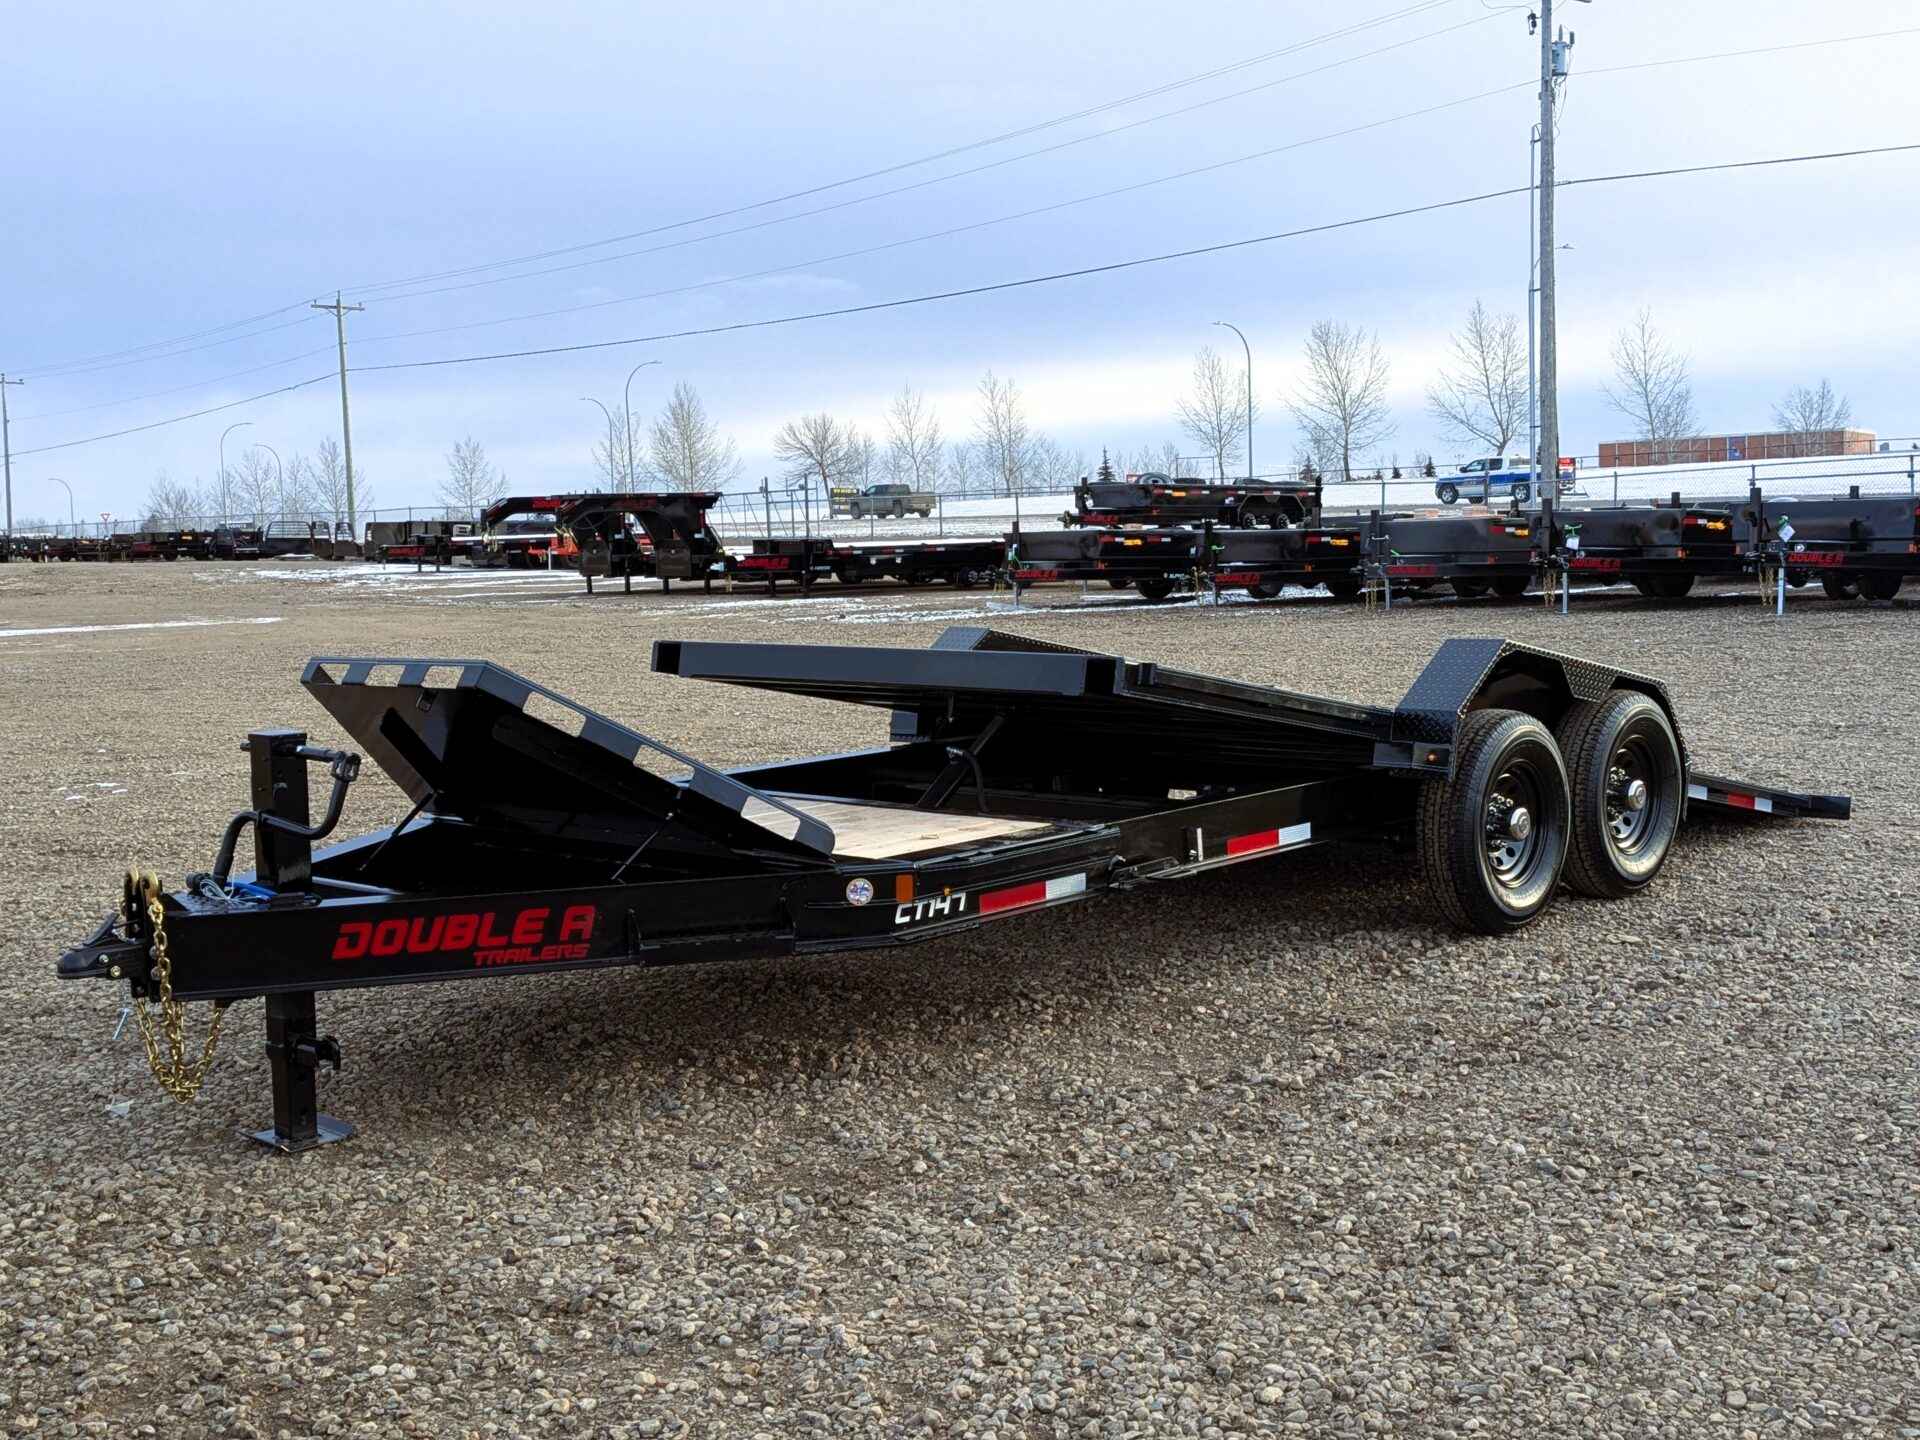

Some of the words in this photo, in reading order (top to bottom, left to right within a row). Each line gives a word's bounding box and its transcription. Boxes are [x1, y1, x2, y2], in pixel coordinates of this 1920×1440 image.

[895, 892, 966, 924] CT147
[332, 907, 549, 960] DOUBLE
[560, 905, 596, 942] A
[473, 943, 590, 966] TRAILERS
